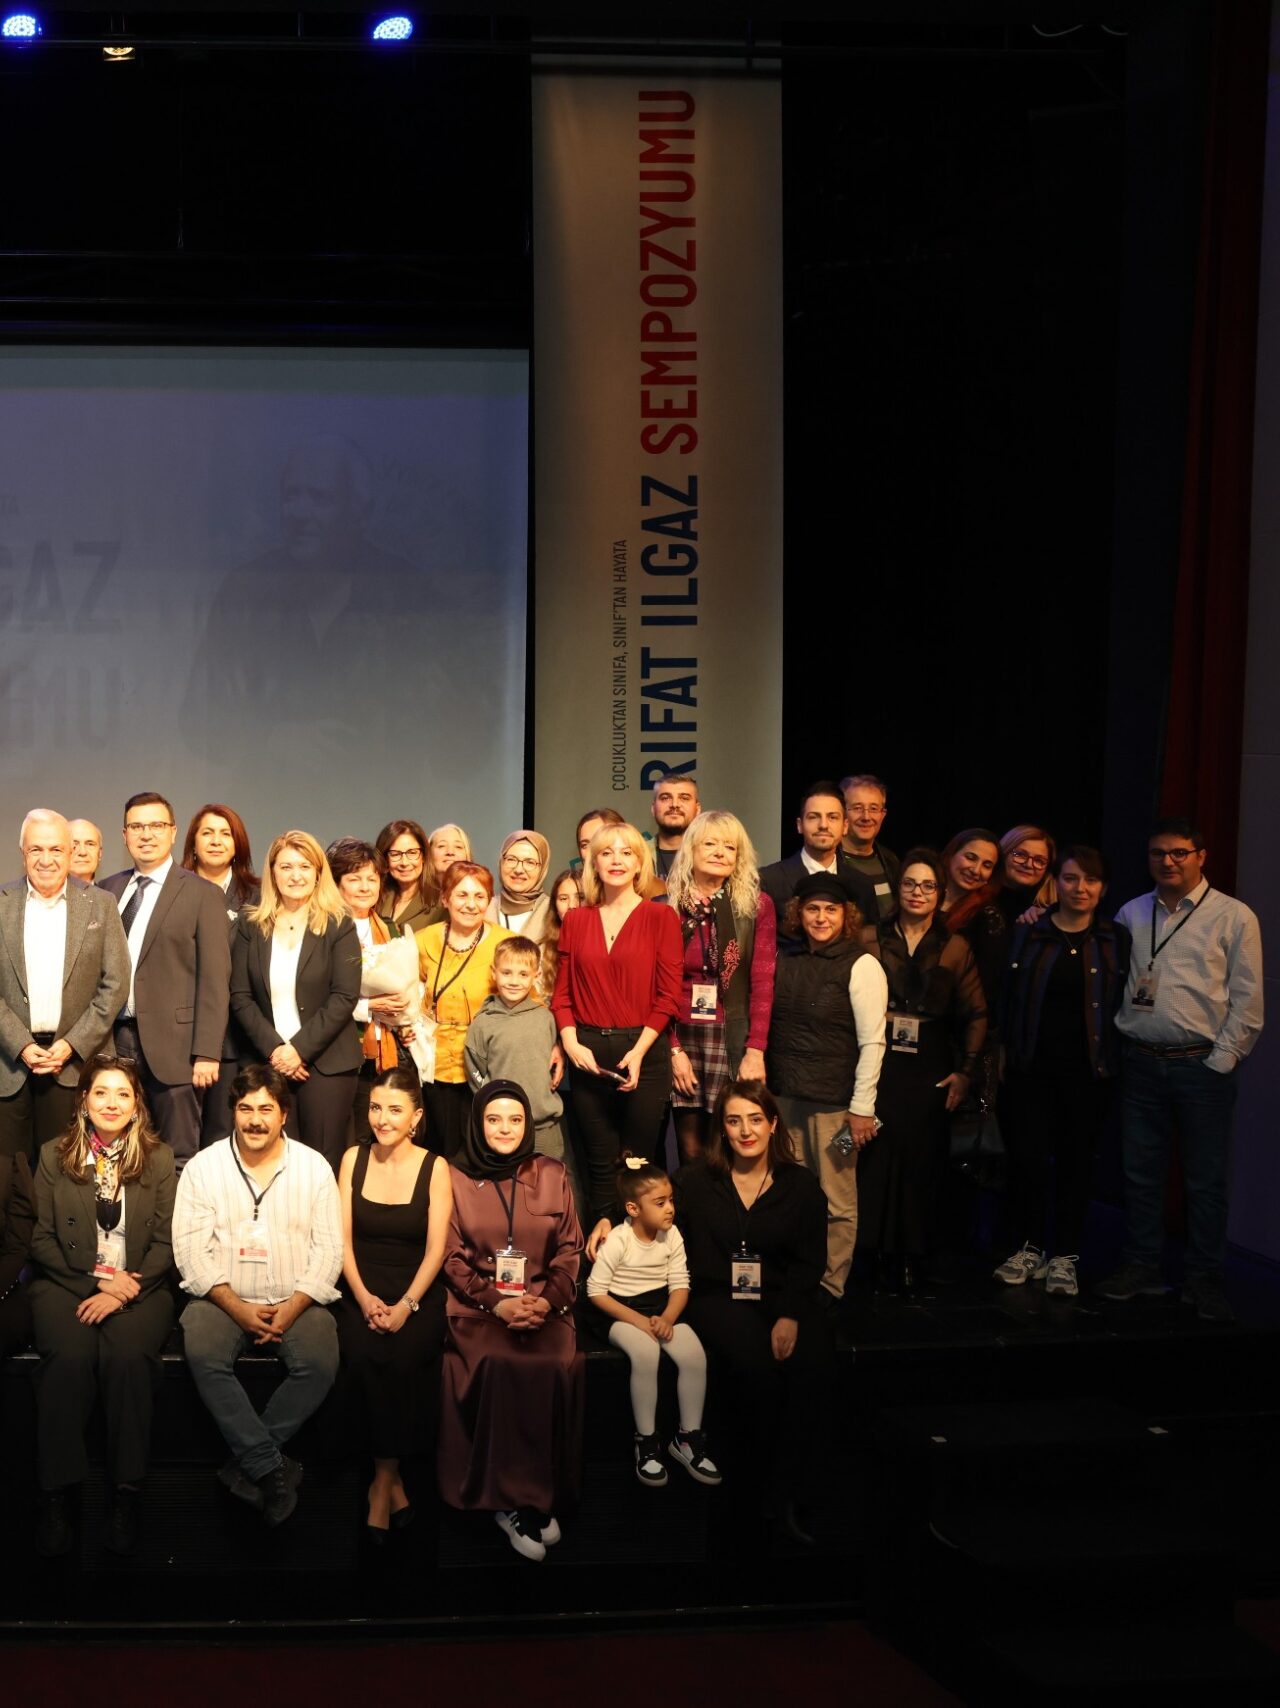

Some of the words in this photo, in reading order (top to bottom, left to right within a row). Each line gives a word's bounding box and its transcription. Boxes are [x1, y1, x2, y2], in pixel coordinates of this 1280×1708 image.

[638, 90, 698, 454] SEMPOZYUMU
[613, 539, 627, 583] HAYATA
[640, 475, 698, 626] ILGAZ
[613, 586, 627, 648] SINIF'TAN
[613, 650, 629, 697] SINIFA,
[640, 646, 698, 791] RIFAT
[612, 700, 630, 791] ÇOCUKLUKTAN
